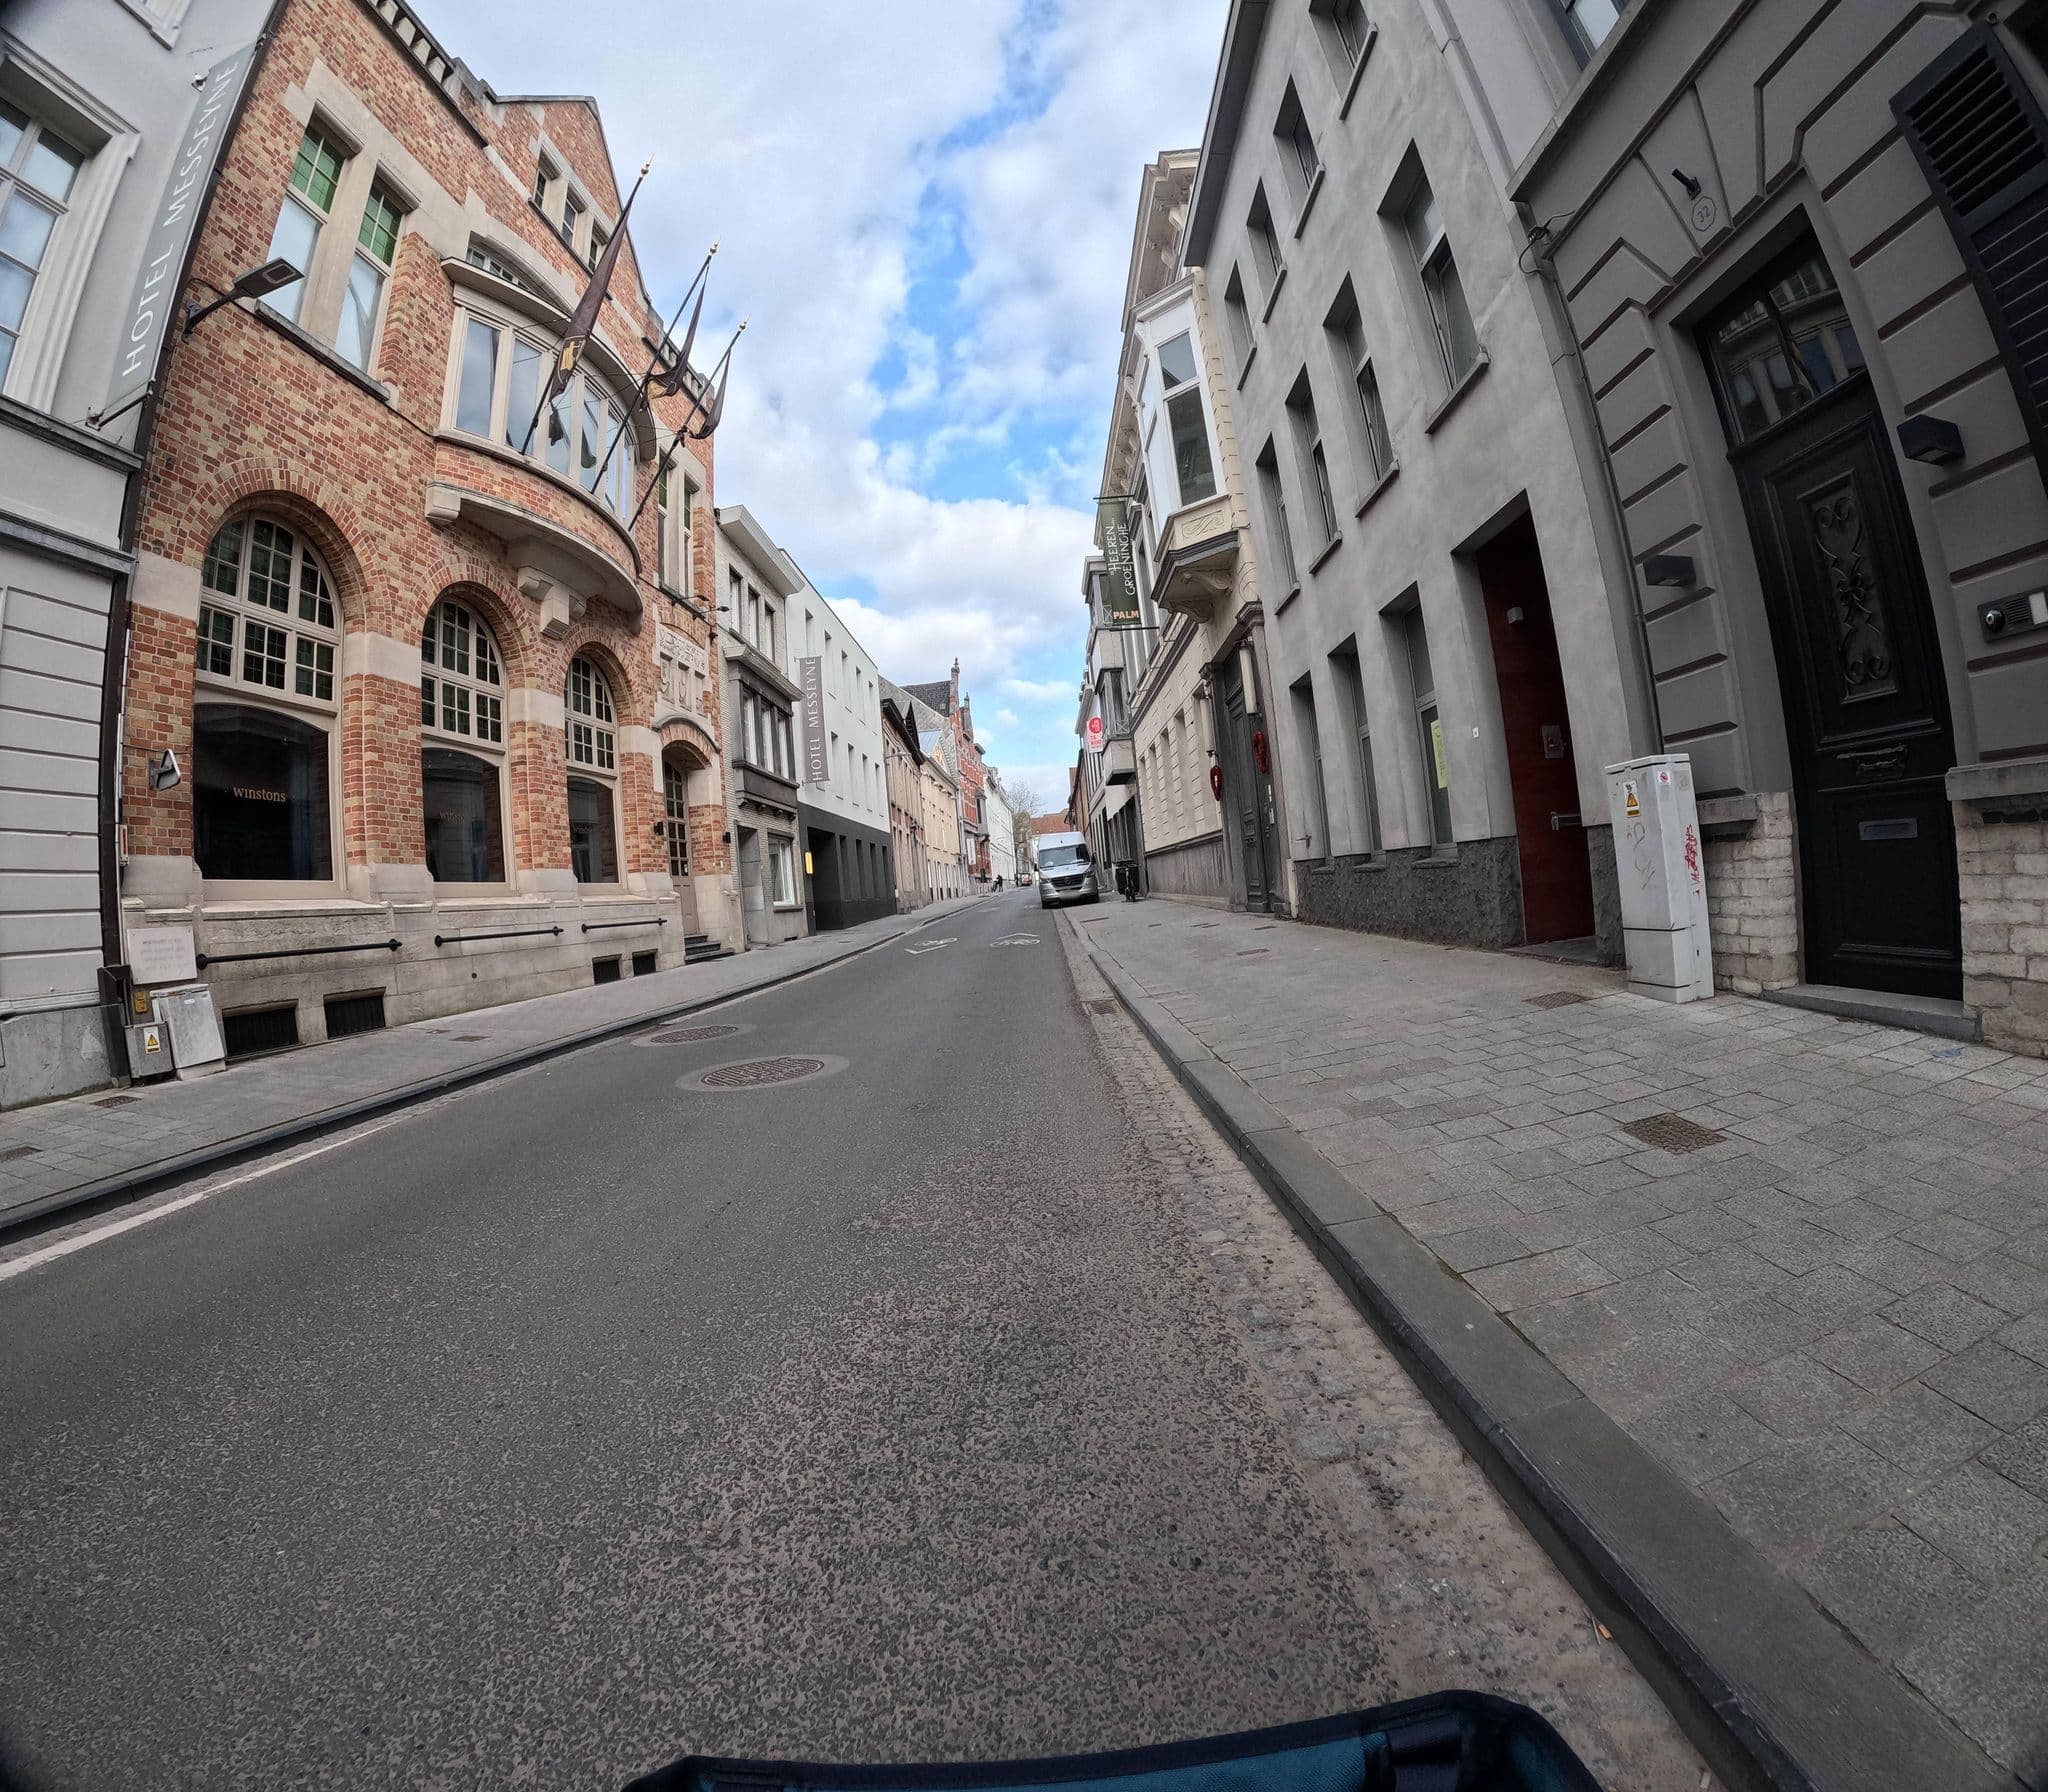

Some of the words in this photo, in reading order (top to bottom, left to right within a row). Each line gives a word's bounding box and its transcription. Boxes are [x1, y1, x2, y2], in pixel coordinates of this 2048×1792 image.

[122, 243, 174, 377] HOTEL
[163, 60, 240, 227] MESSEYNE
[1697, 205, 1711, 223] 32
[1105, 525, 1120, 572] HEEREN
[1117, 522, 1136, 596] GROENINGHE
[1113, 610, 1140, 620] PALM
[805, 657, 819, 728] MESSEYNE
[809, 735, 823, 781] HOTEL
[233, 787, 287, 802] winstons
